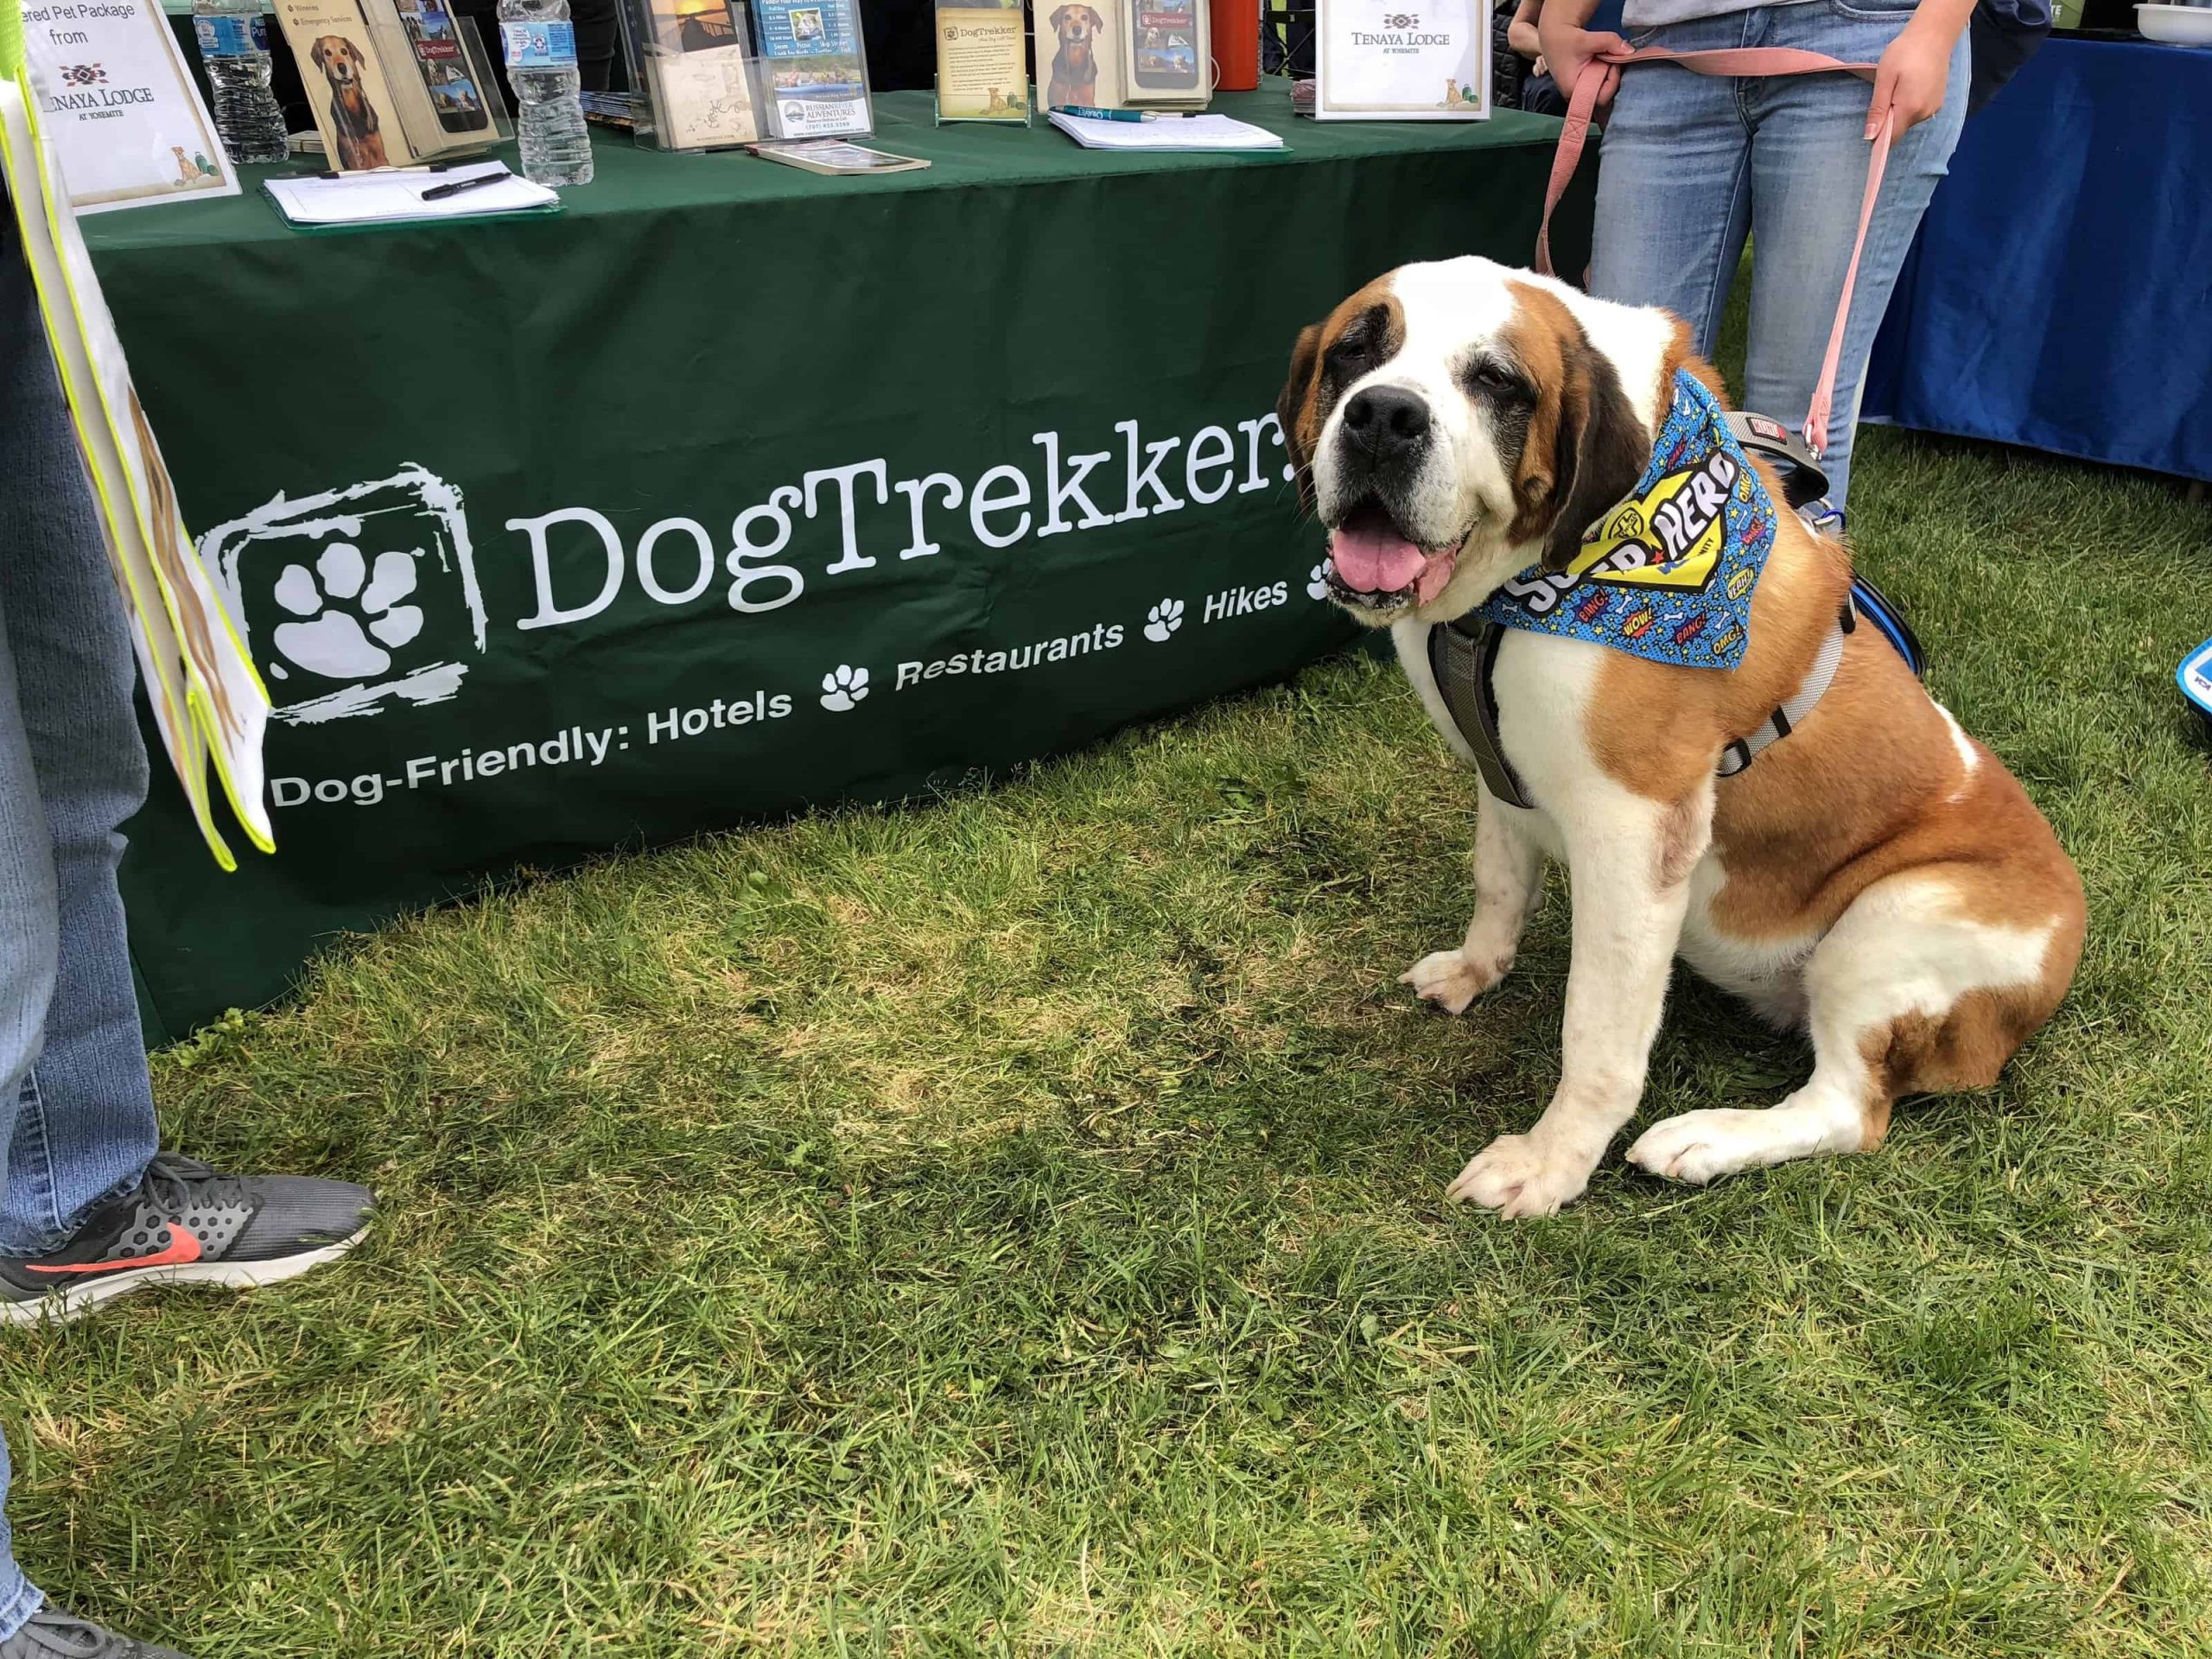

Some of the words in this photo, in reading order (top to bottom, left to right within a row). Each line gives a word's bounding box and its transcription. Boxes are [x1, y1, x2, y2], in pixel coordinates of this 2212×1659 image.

[52, 5, 77, 20] Pet
[78, 3, 135, 20] Package
[49, 29, 88, 46] from
[960, 26, 1017, 37] DogTrekker
[1351, 32, 1403, 46] TENAYA
[1407, 32, 1450, 46] LODGE
[100, 87, 155, 107] LODGE
[88, 109, 124, 120] YOSEMITE
[807, 109, 856, 119] ADVENTURES
[1654, 452, 1735, 560] HERO
[1579, 588, 1609, 622] BANG!
[1623, 607, 1653, 636] WOW!
[1676, 613, 1707, 645] BANG!
[1713, 624, 1741, 654] OMG!
[270, 726, 628, 806] Dog-Friendly:
[648, 690, 791, 744] Hotels
[896, 624, 1123, 690] Restaurants
[1204, 582, 1287, 623] Hikes
